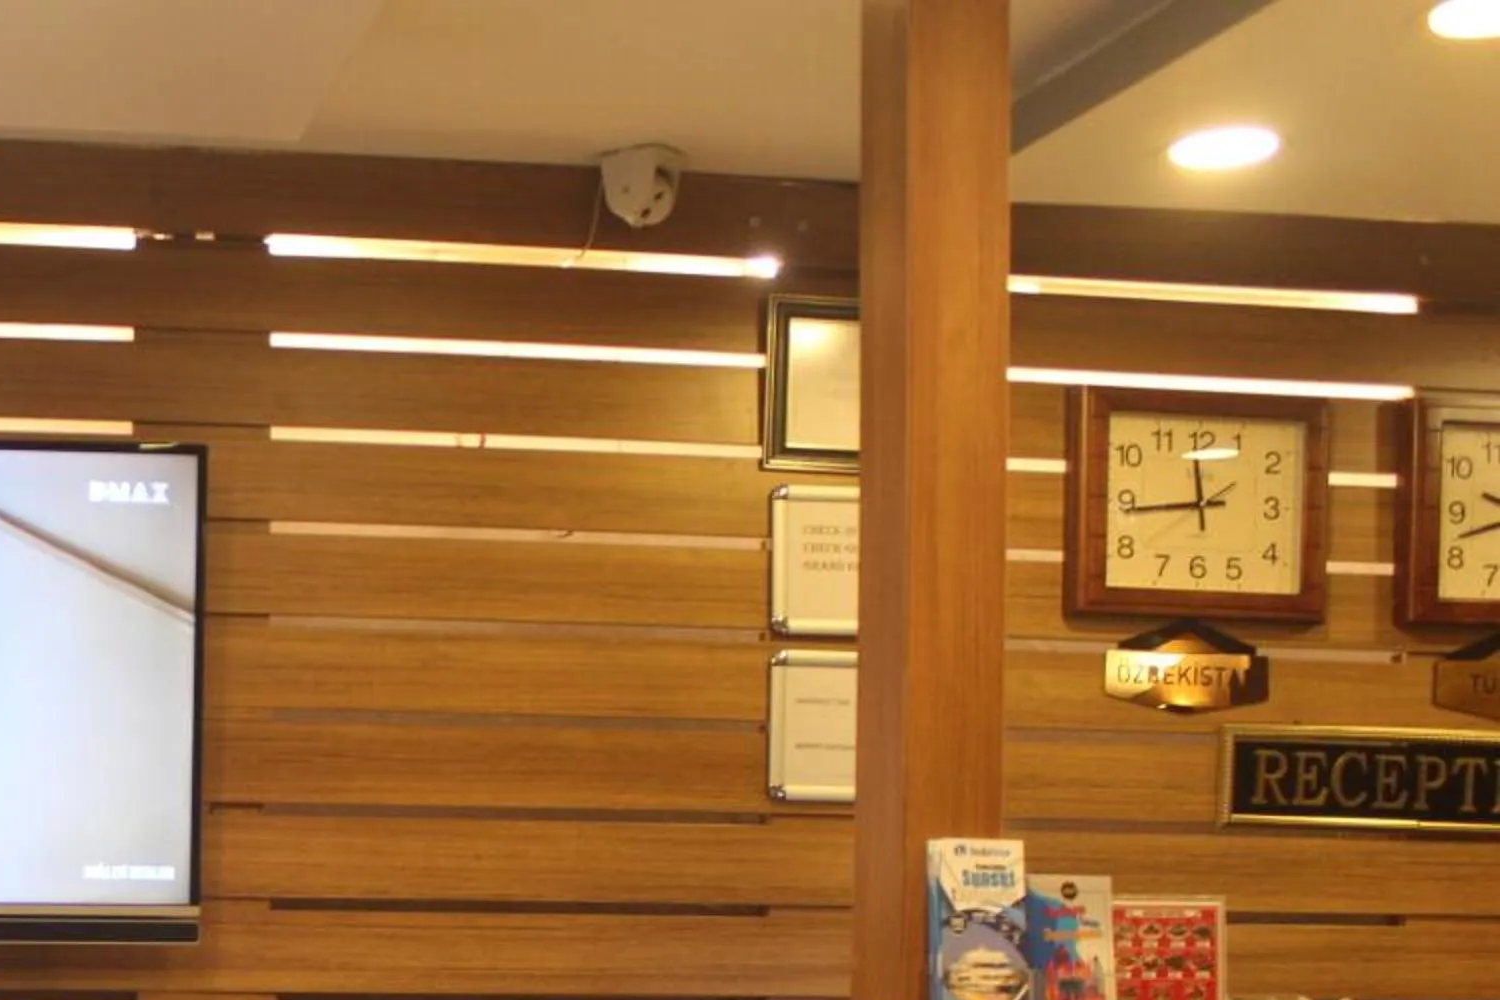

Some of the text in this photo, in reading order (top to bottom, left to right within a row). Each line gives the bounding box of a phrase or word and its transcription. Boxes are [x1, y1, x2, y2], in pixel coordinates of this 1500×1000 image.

[1151, 428, 1174, 452] 11
[1188, 431, 1216, 452] 12
[1232, 433, 1242, 452] 1
[1115, 443, 1143, 468] 10
[1264, 451, 1281, 475] 2
[1447, 455, 1473, 480] 10
[88, 480, 170, 504] DMAX
[1118, 489, 1136, 514] 9
[1263, 496, 1280, 521] 3
[1448, 500, 1466, 525] 9
[1116, 535, 1135, 559] 8
[1262, 543, 1279, 566] 4
[1447, 546, 1465, 570] 8
[1155, 554, 1171, 578] 7
[1188, 556, 1208, 580] 6
[1225, 557, 1243, 580] 5
[1482, 564, 1499, 588] 7
